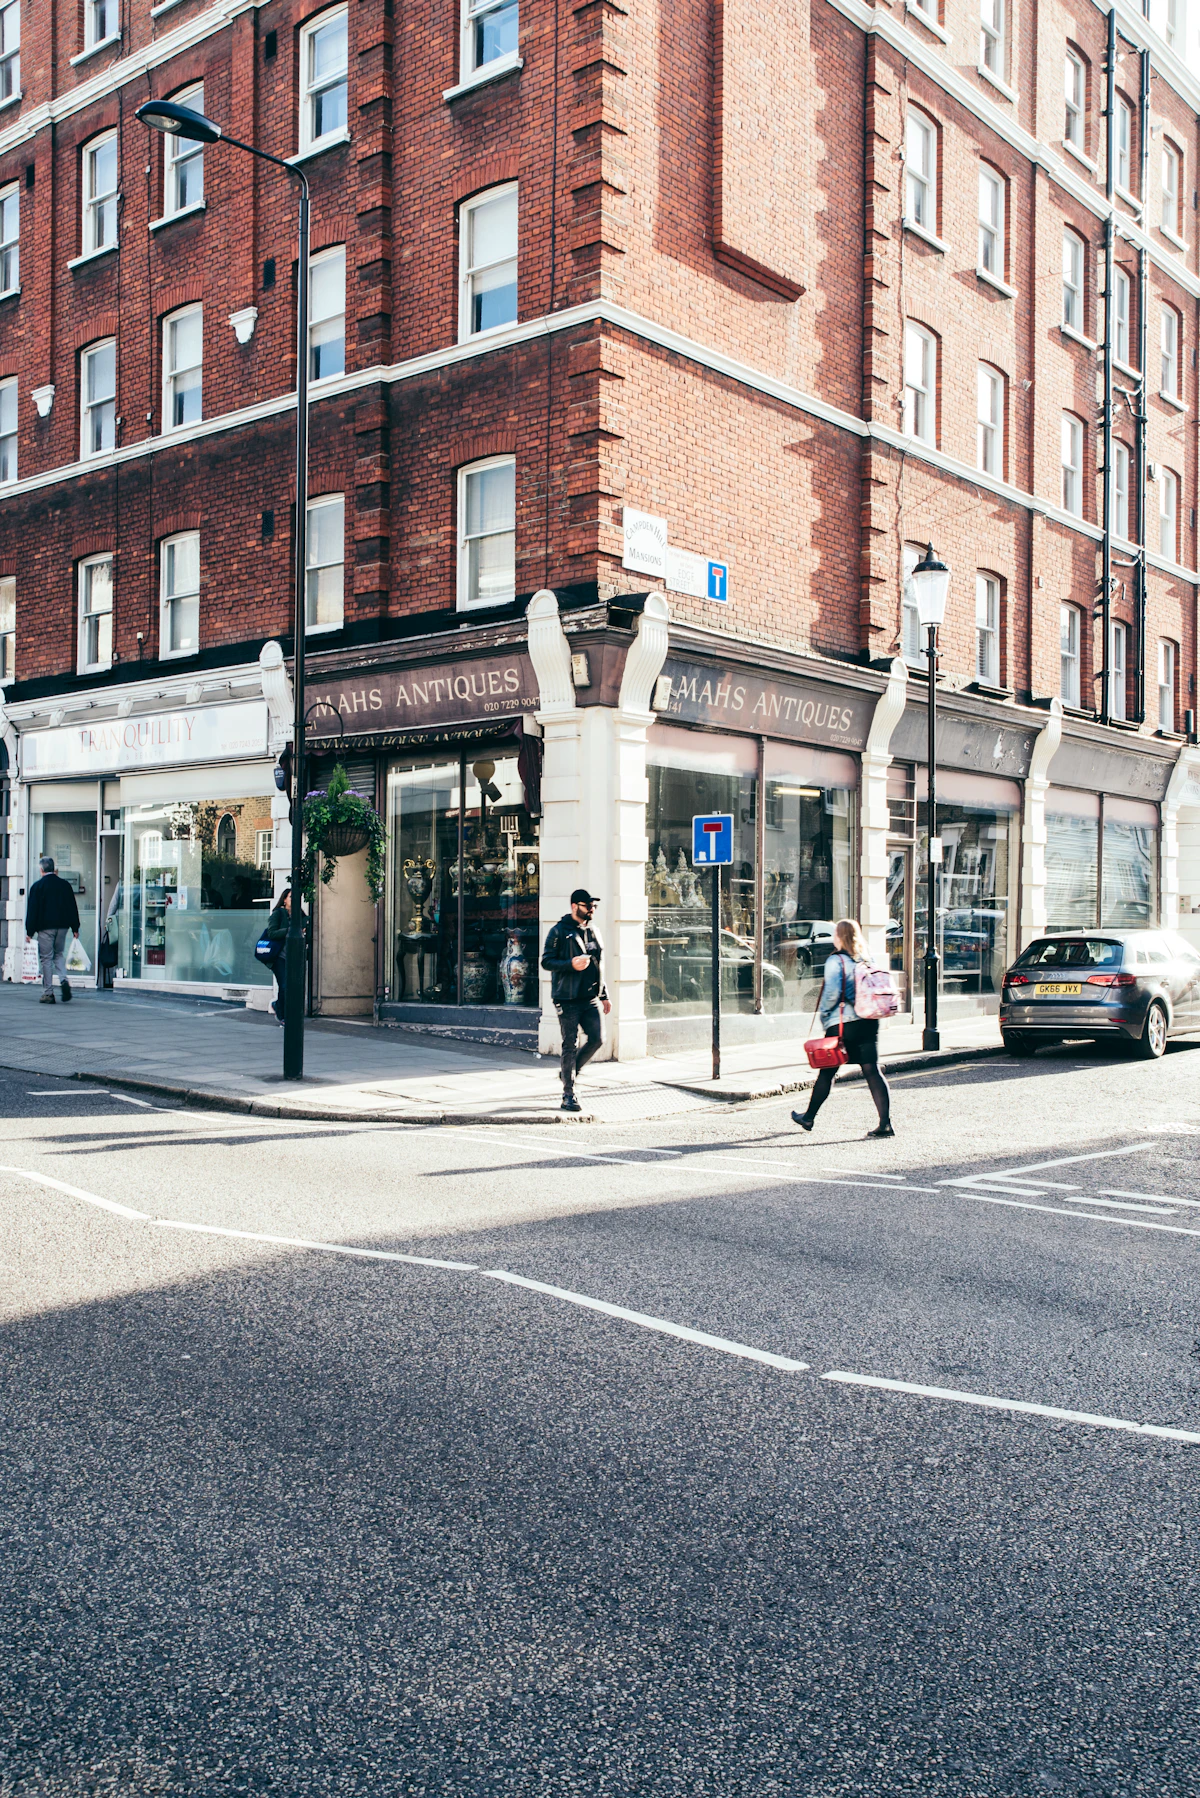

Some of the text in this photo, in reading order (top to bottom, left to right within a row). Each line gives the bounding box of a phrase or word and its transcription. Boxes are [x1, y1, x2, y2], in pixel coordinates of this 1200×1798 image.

[625, 520, 666, 549] CAMPDEN HILL
[628, 547, 662, 566] MANSIONS
[668, 576, 690, 591] STREET
[678, 568, 695, 582] EDGE
[316, 668, 520, 719] MAHS ANTIQUES
[484, 696, 540, 712] 020 7229 9047
[677, 676, 747, 711] MAHS
[753, 692, 854, 732] ANTIQUES
[78, 716, 196, 753] TRANQUILITY
[1039, 984, 1079, 993] GK66 JVX
